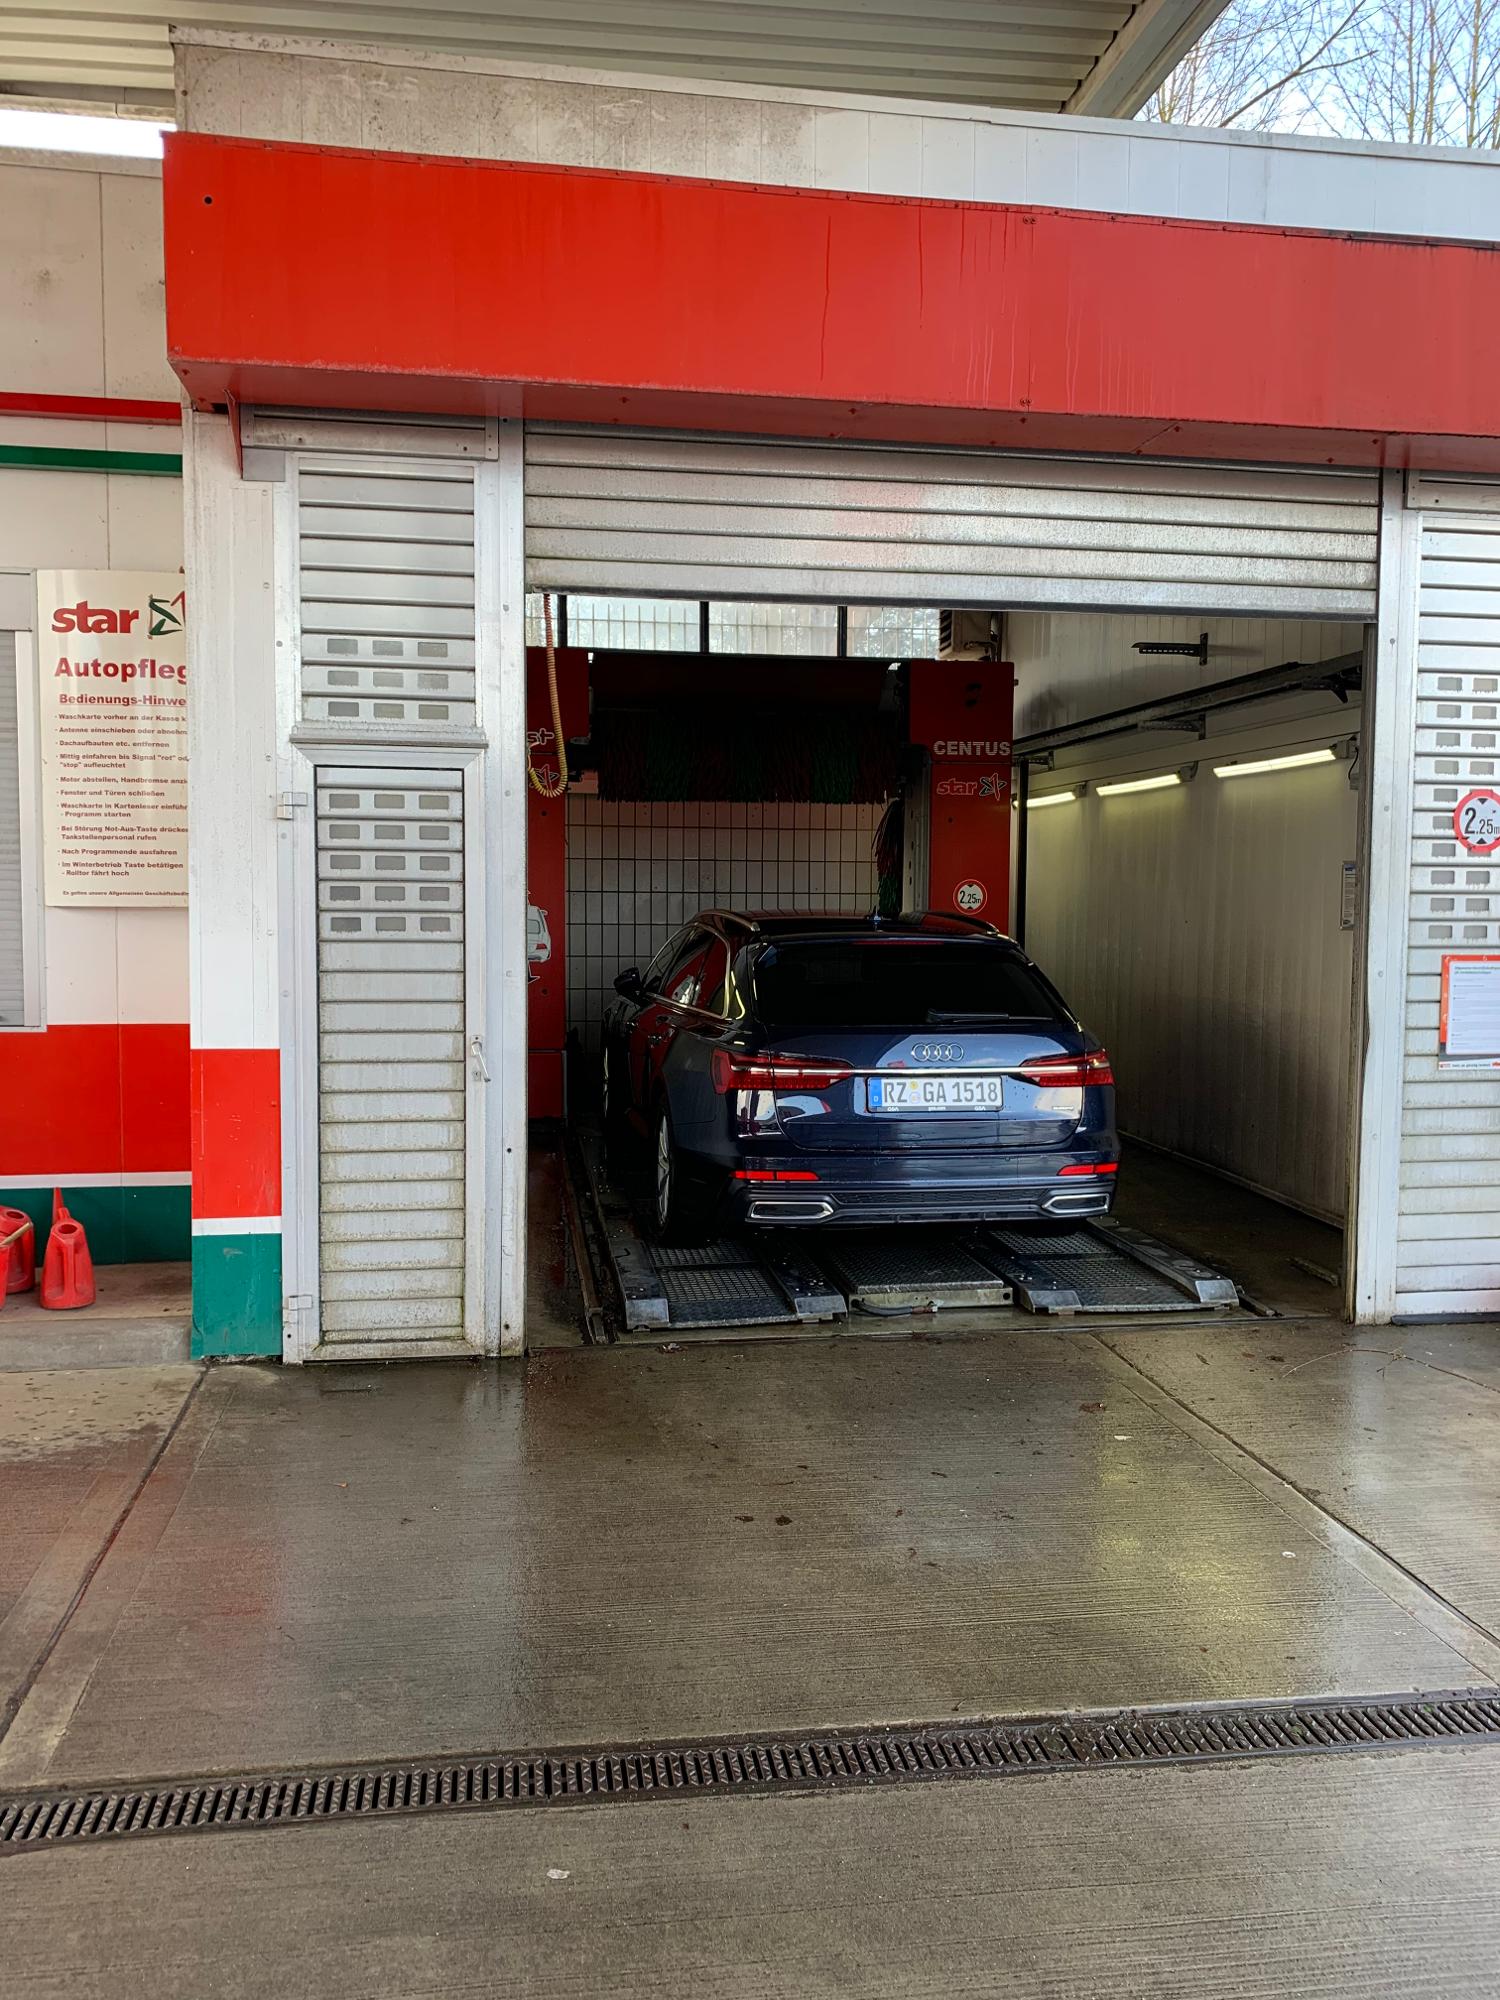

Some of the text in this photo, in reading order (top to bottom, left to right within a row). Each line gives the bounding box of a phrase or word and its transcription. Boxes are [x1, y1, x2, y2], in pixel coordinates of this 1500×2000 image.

[52, 601, 139, 634] star
[933, 741, 1010, 756] CENTUS
[936, 777, 978, 796] star
[105, 789, 126, 797] Türen
[74, 825, 102, 833] Störung
[61, 833, 135, 841] Tankstellenpersonal
[81, 848, 137, 856] Programmende
[147, 861, 184, 869] betätigen
[884, 1081, 998, 1103] RZ GA 1518
